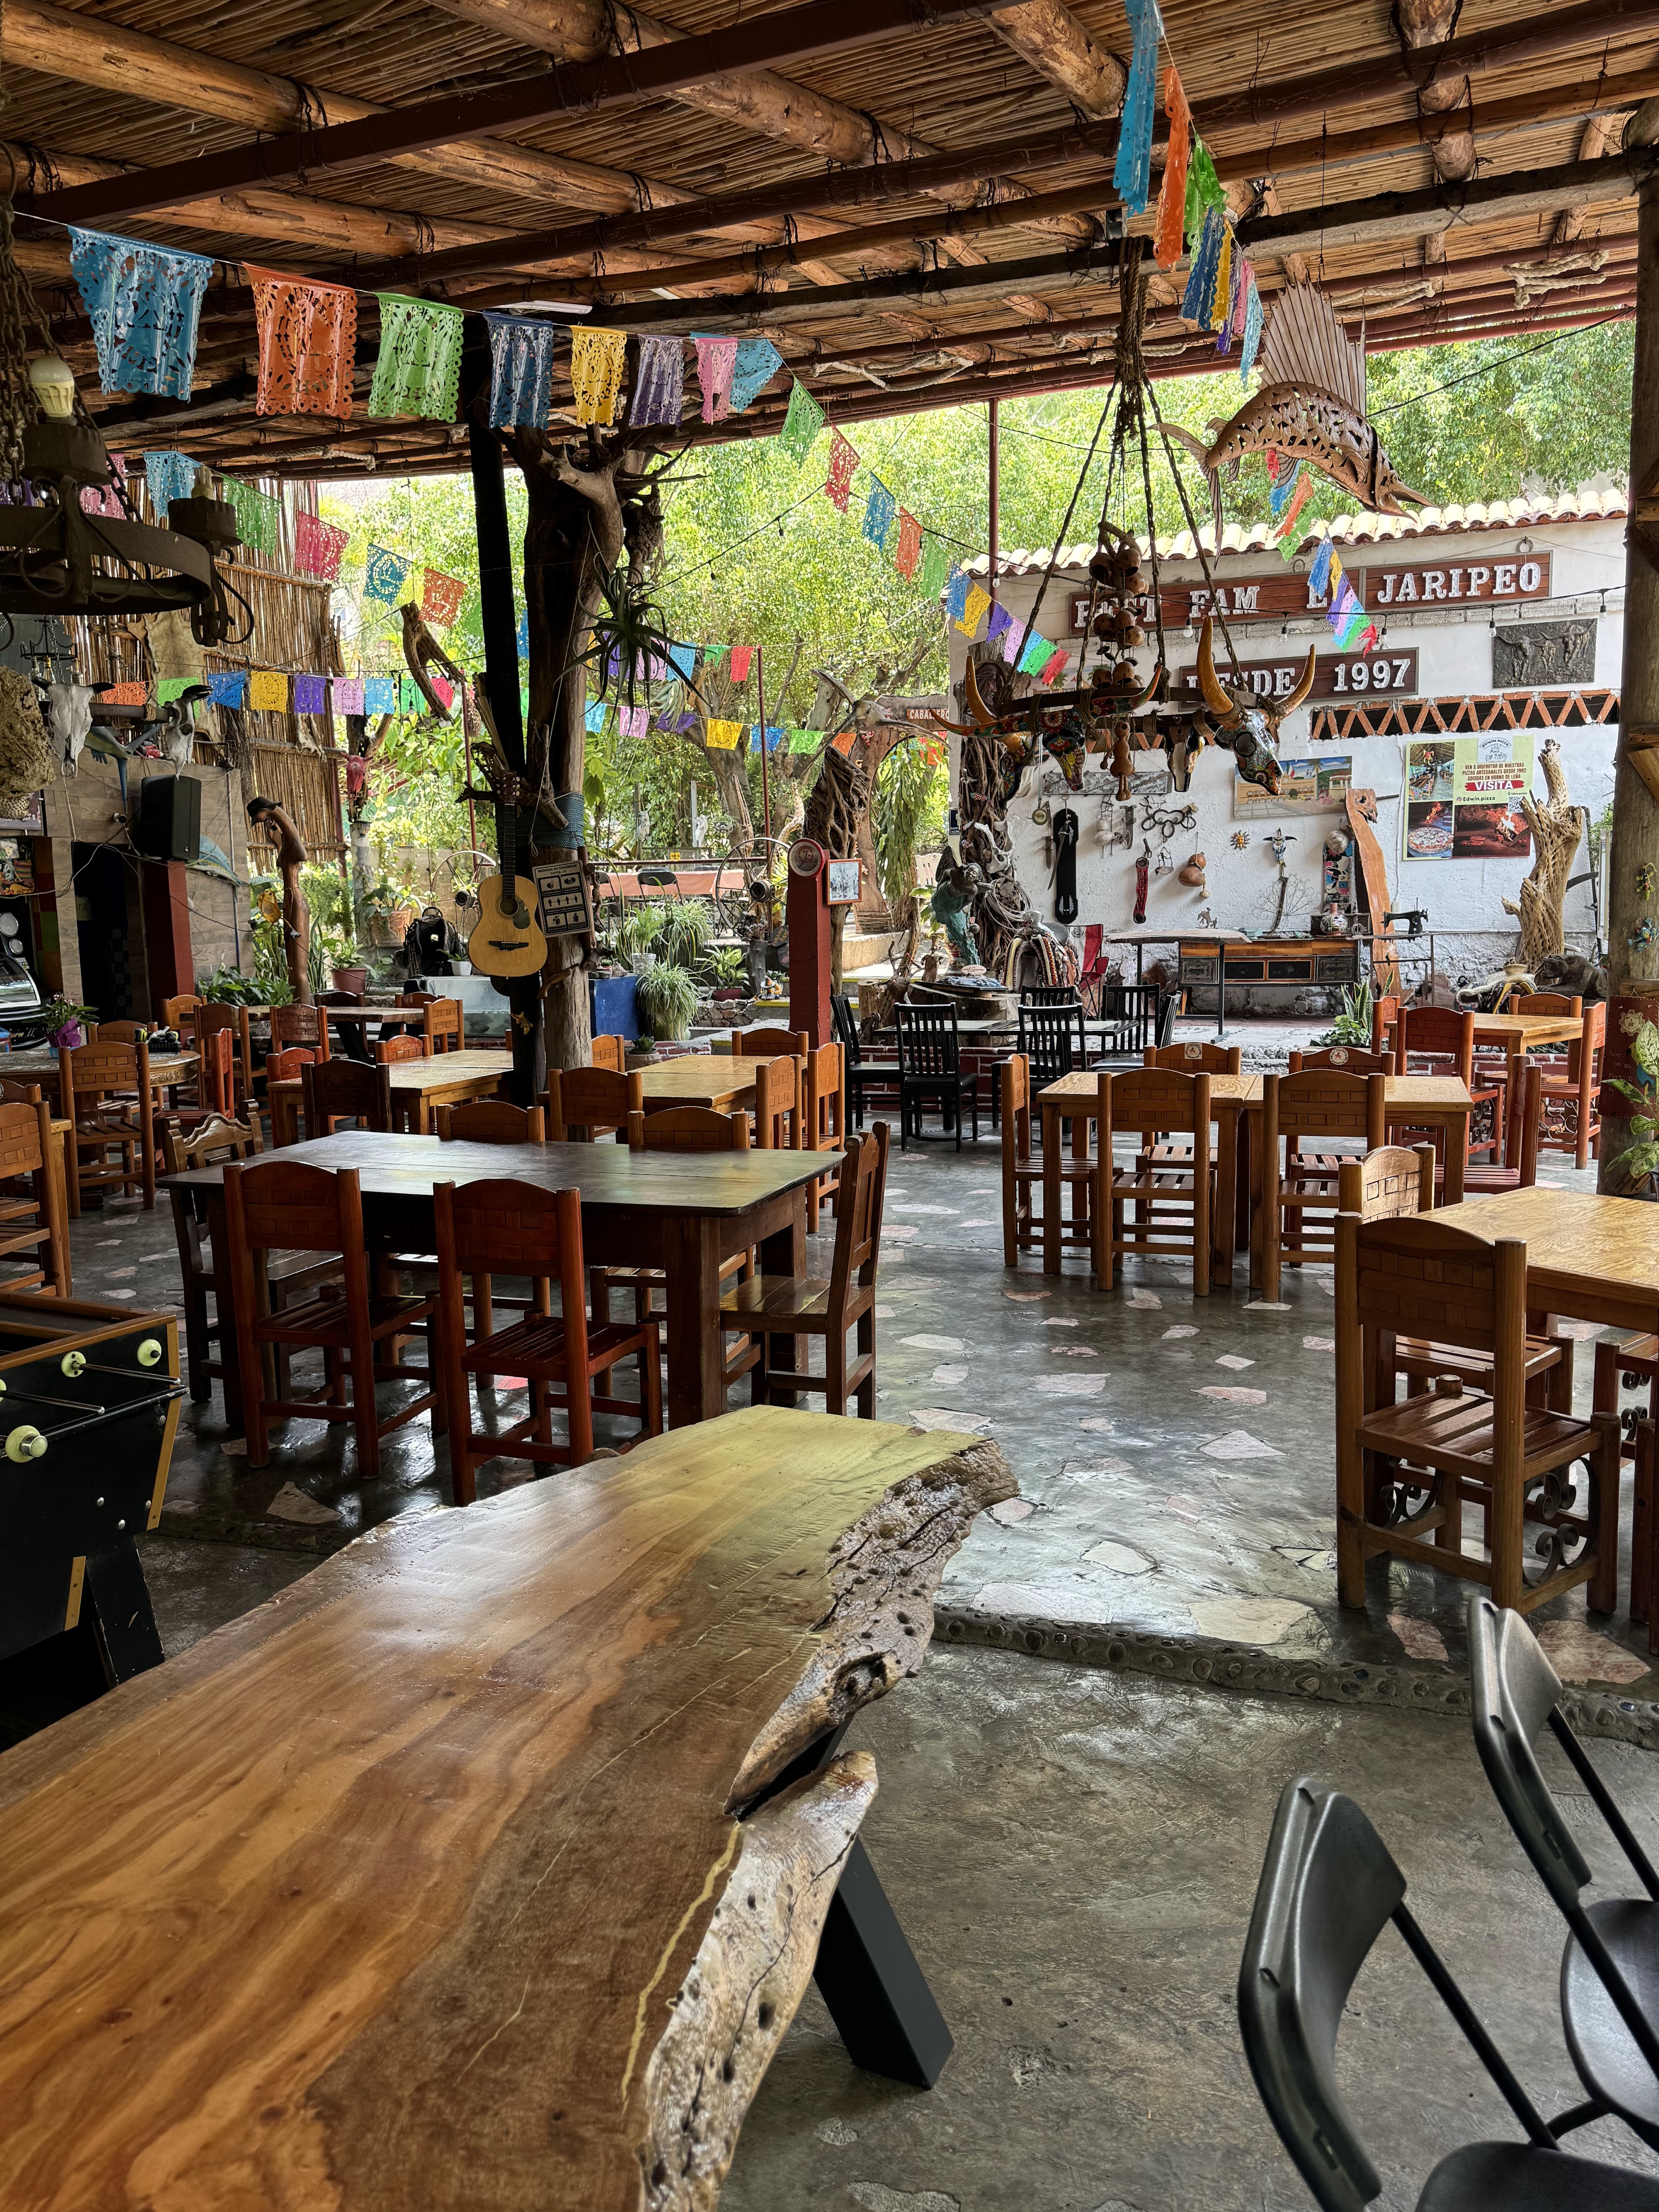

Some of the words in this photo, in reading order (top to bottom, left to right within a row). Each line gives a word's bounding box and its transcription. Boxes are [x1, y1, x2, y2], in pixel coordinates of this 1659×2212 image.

[1189, 586, 1259, 618] FAM
[1377, 562, 1541, 603] JARIPEO
[1334, 658, 1411, 692] 1997
[1482, 739, 1496, 747] EDWIN
[1475, 781, 1513, 790] VISITA
